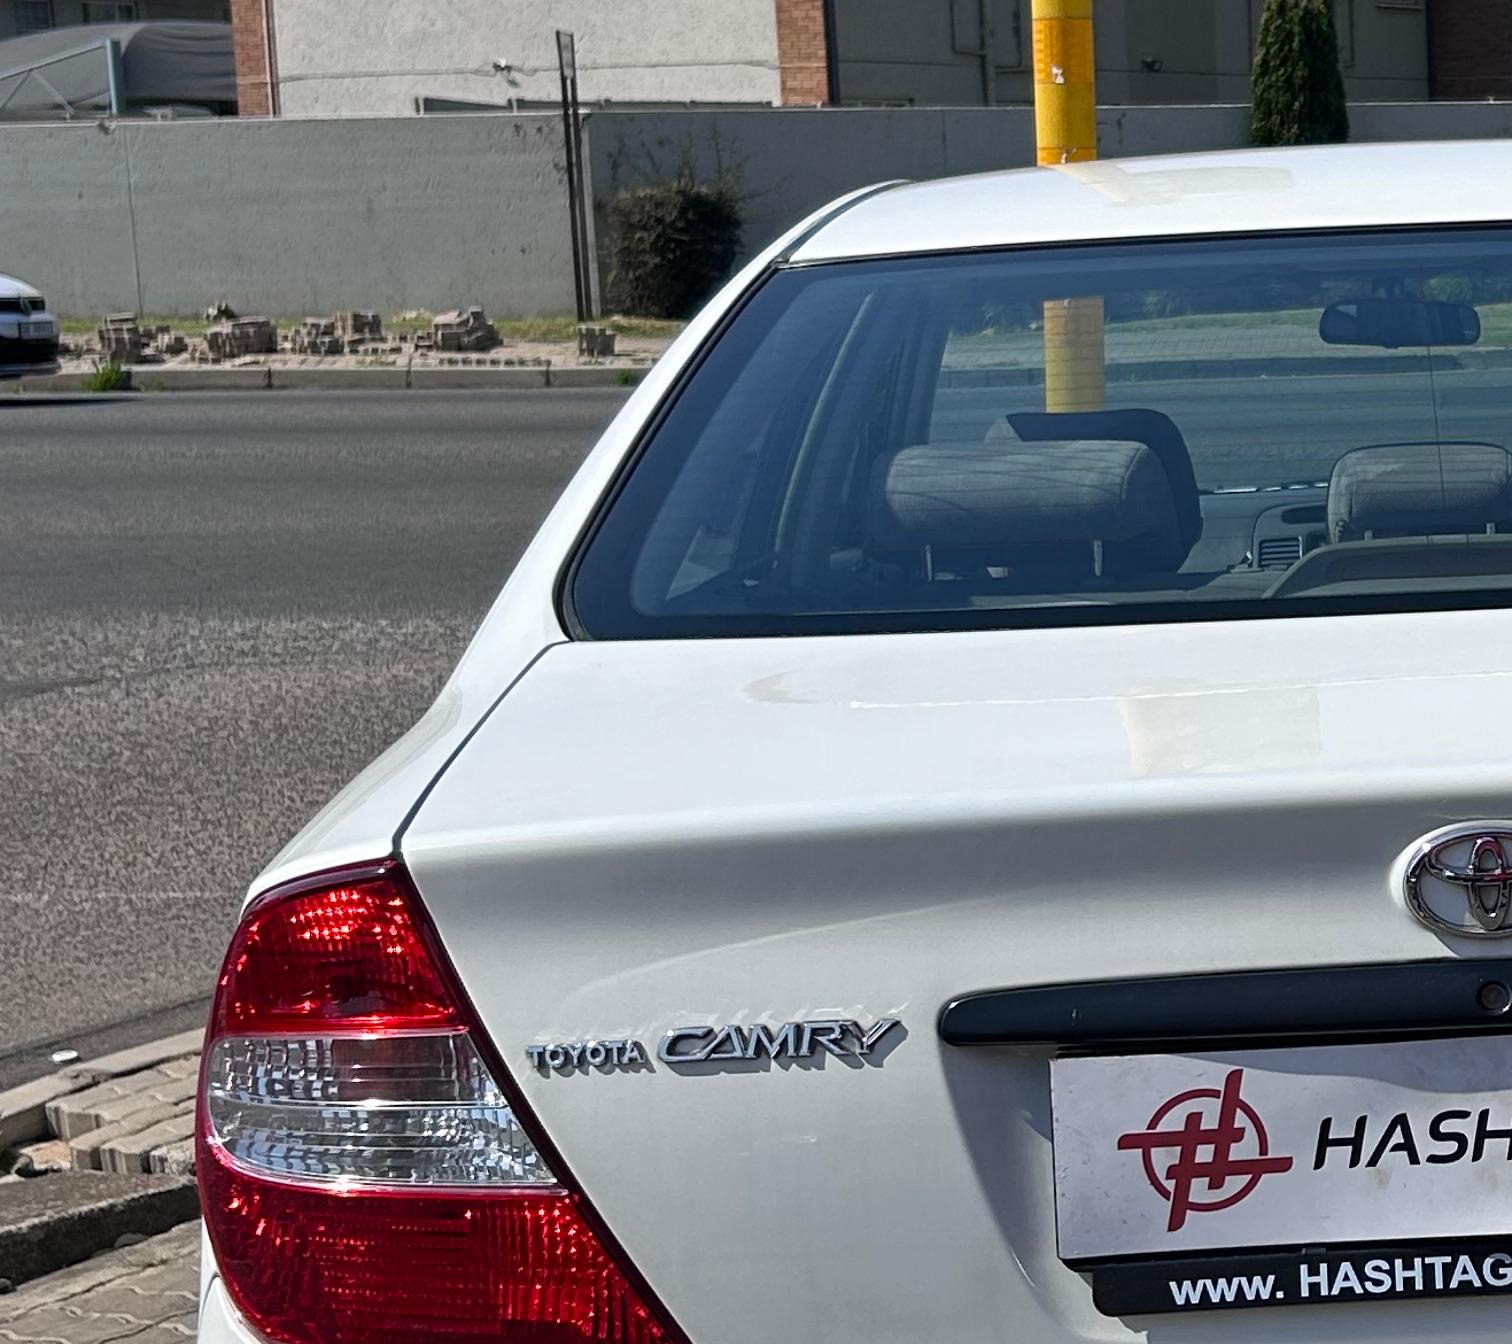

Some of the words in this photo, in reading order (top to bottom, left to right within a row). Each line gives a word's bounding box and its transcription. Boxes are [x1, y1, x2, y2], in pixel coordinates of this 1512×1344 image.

[526, 1039, 646, 1069] TOYOTA
[656, 1018, 901, 1063] CAMRY
[1168, 1274, 1285, 1306] www.
